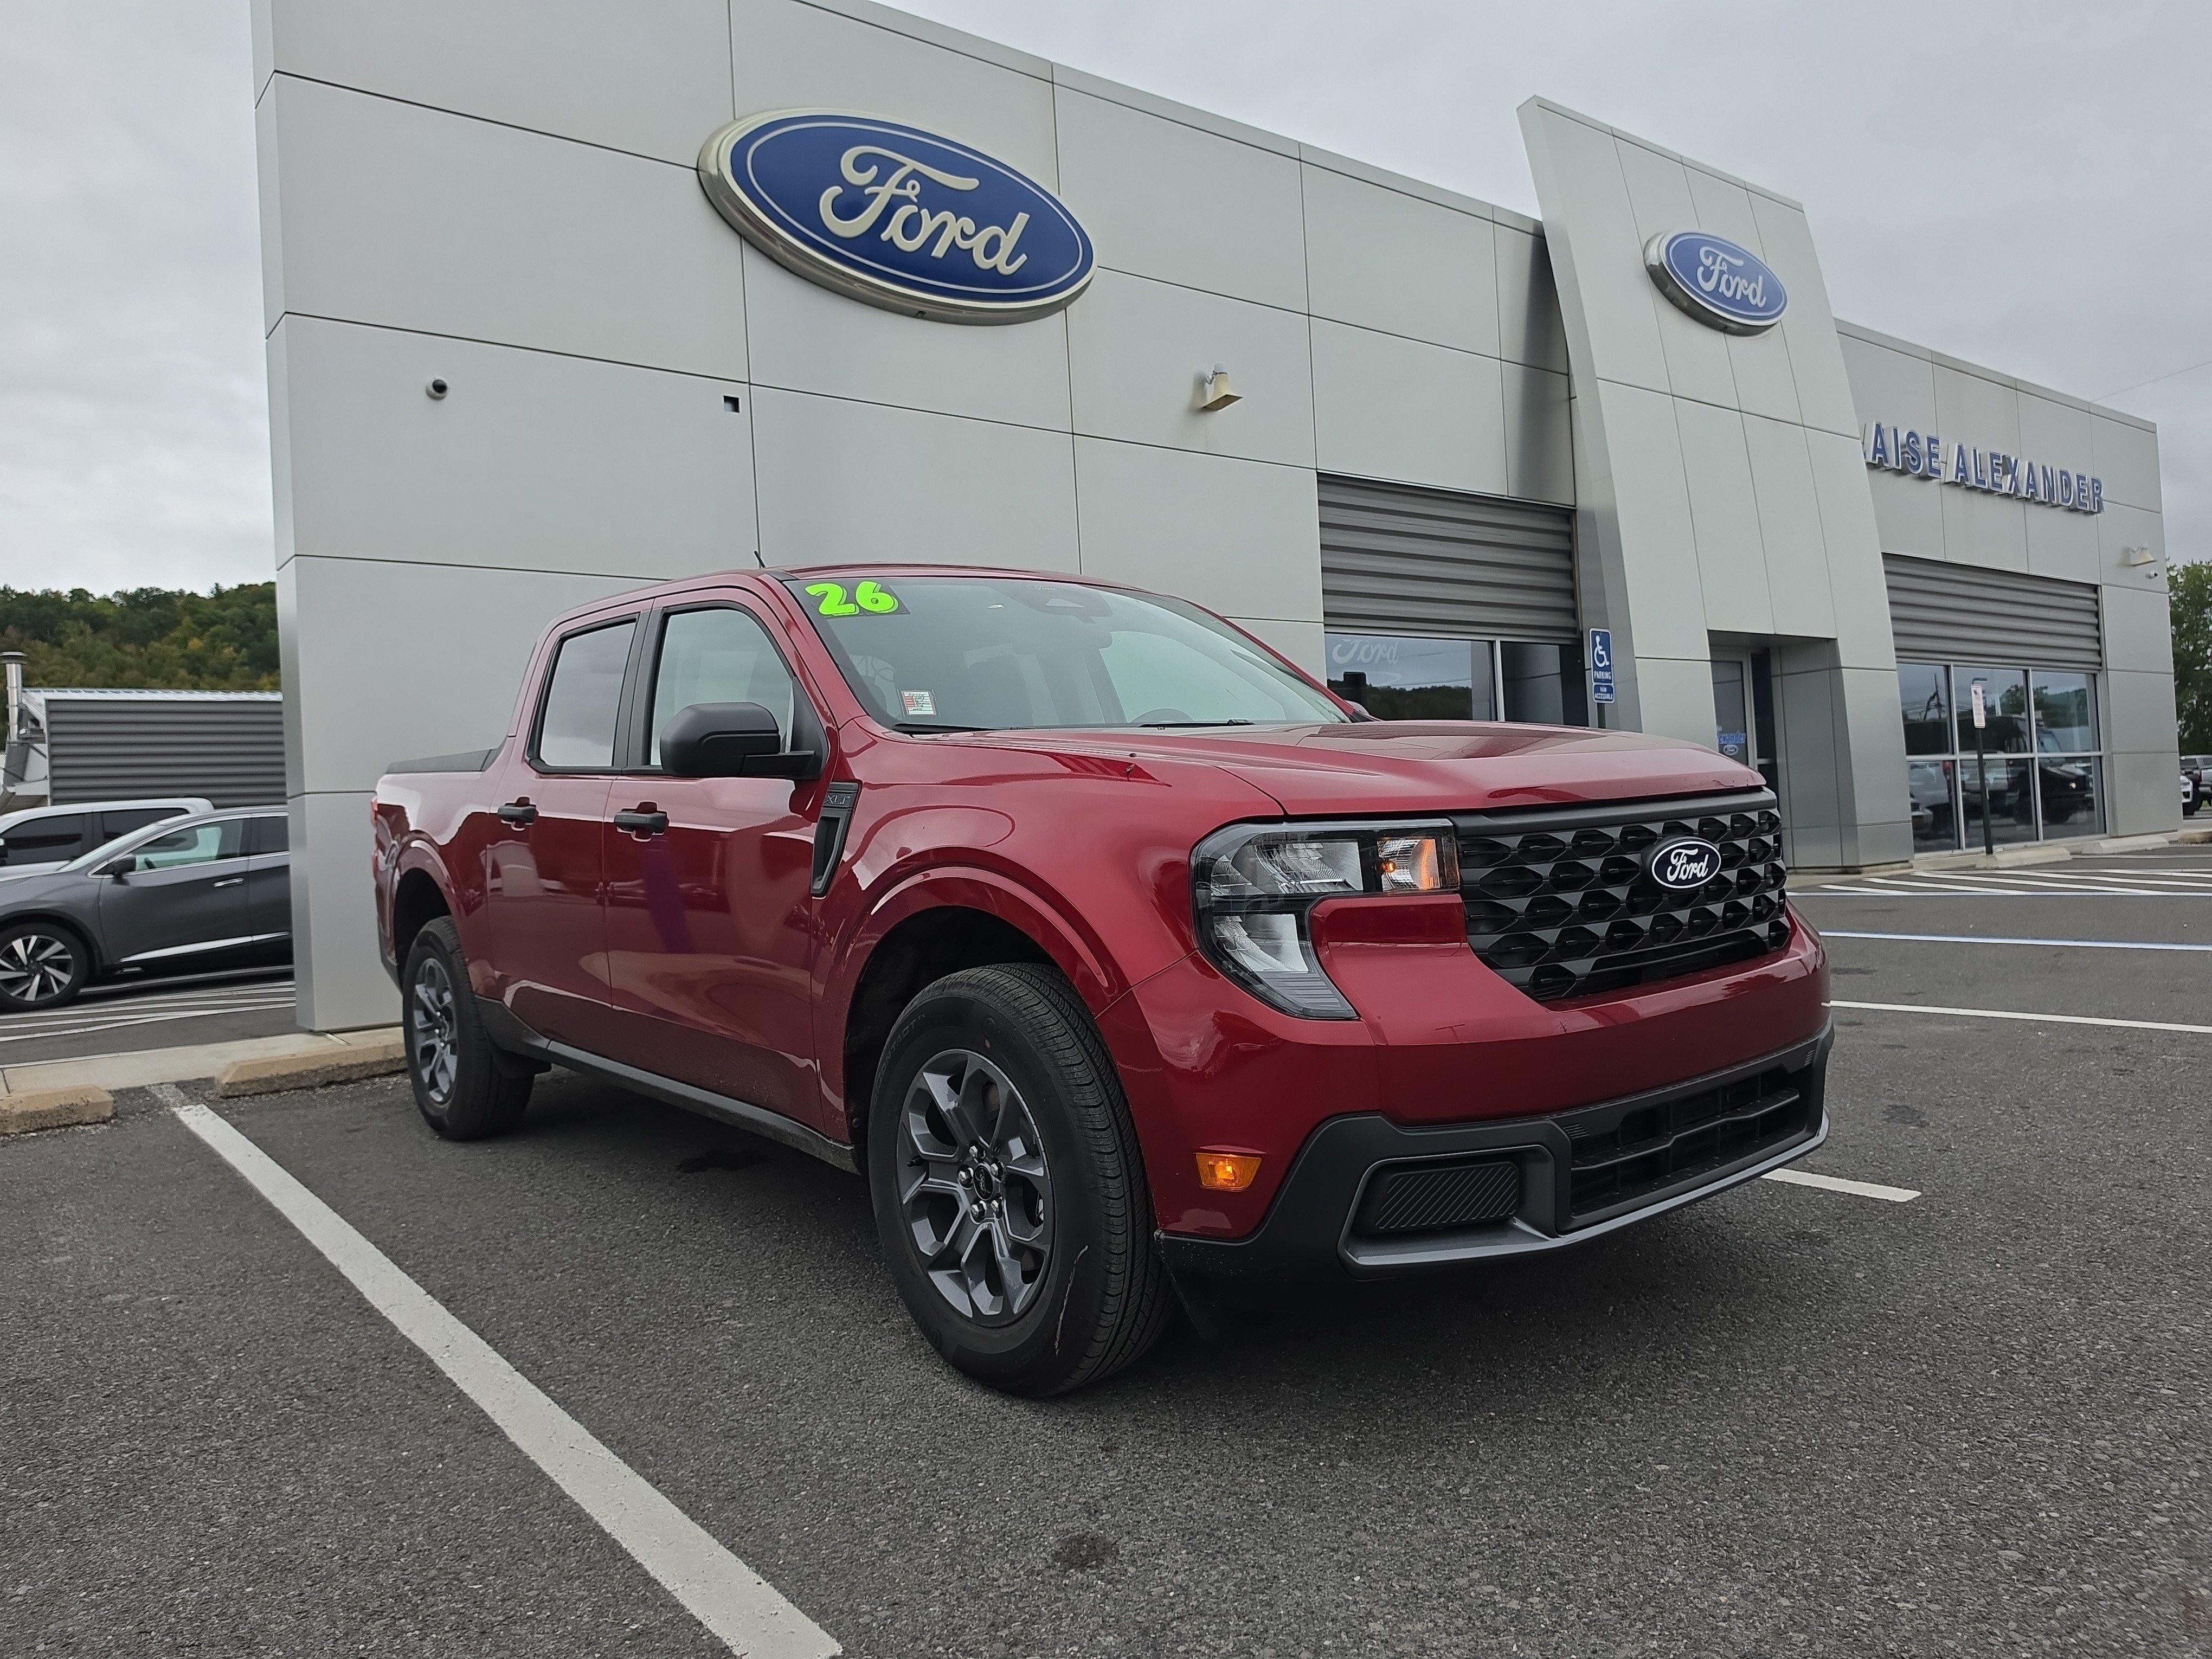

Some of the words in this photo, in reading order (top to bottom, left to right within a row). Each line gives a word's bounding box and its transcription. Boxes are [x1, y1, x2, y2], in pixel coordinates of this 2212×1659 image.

[819, 145, 1030, 276] Ford
[1696, 245, 1766, 308] Ford
[1865, 422, 1942, 478] AISE
[1953, 442, 2105, 513] ALEXANDER
[805, 581, 899, 616] 26
[1332, 639, 1399, 665] Ford
[1594, 670, 1611, 680] PARKING
[825, 794, 851, 805] XLT
[1667, 848, 1709, 882] Ford
